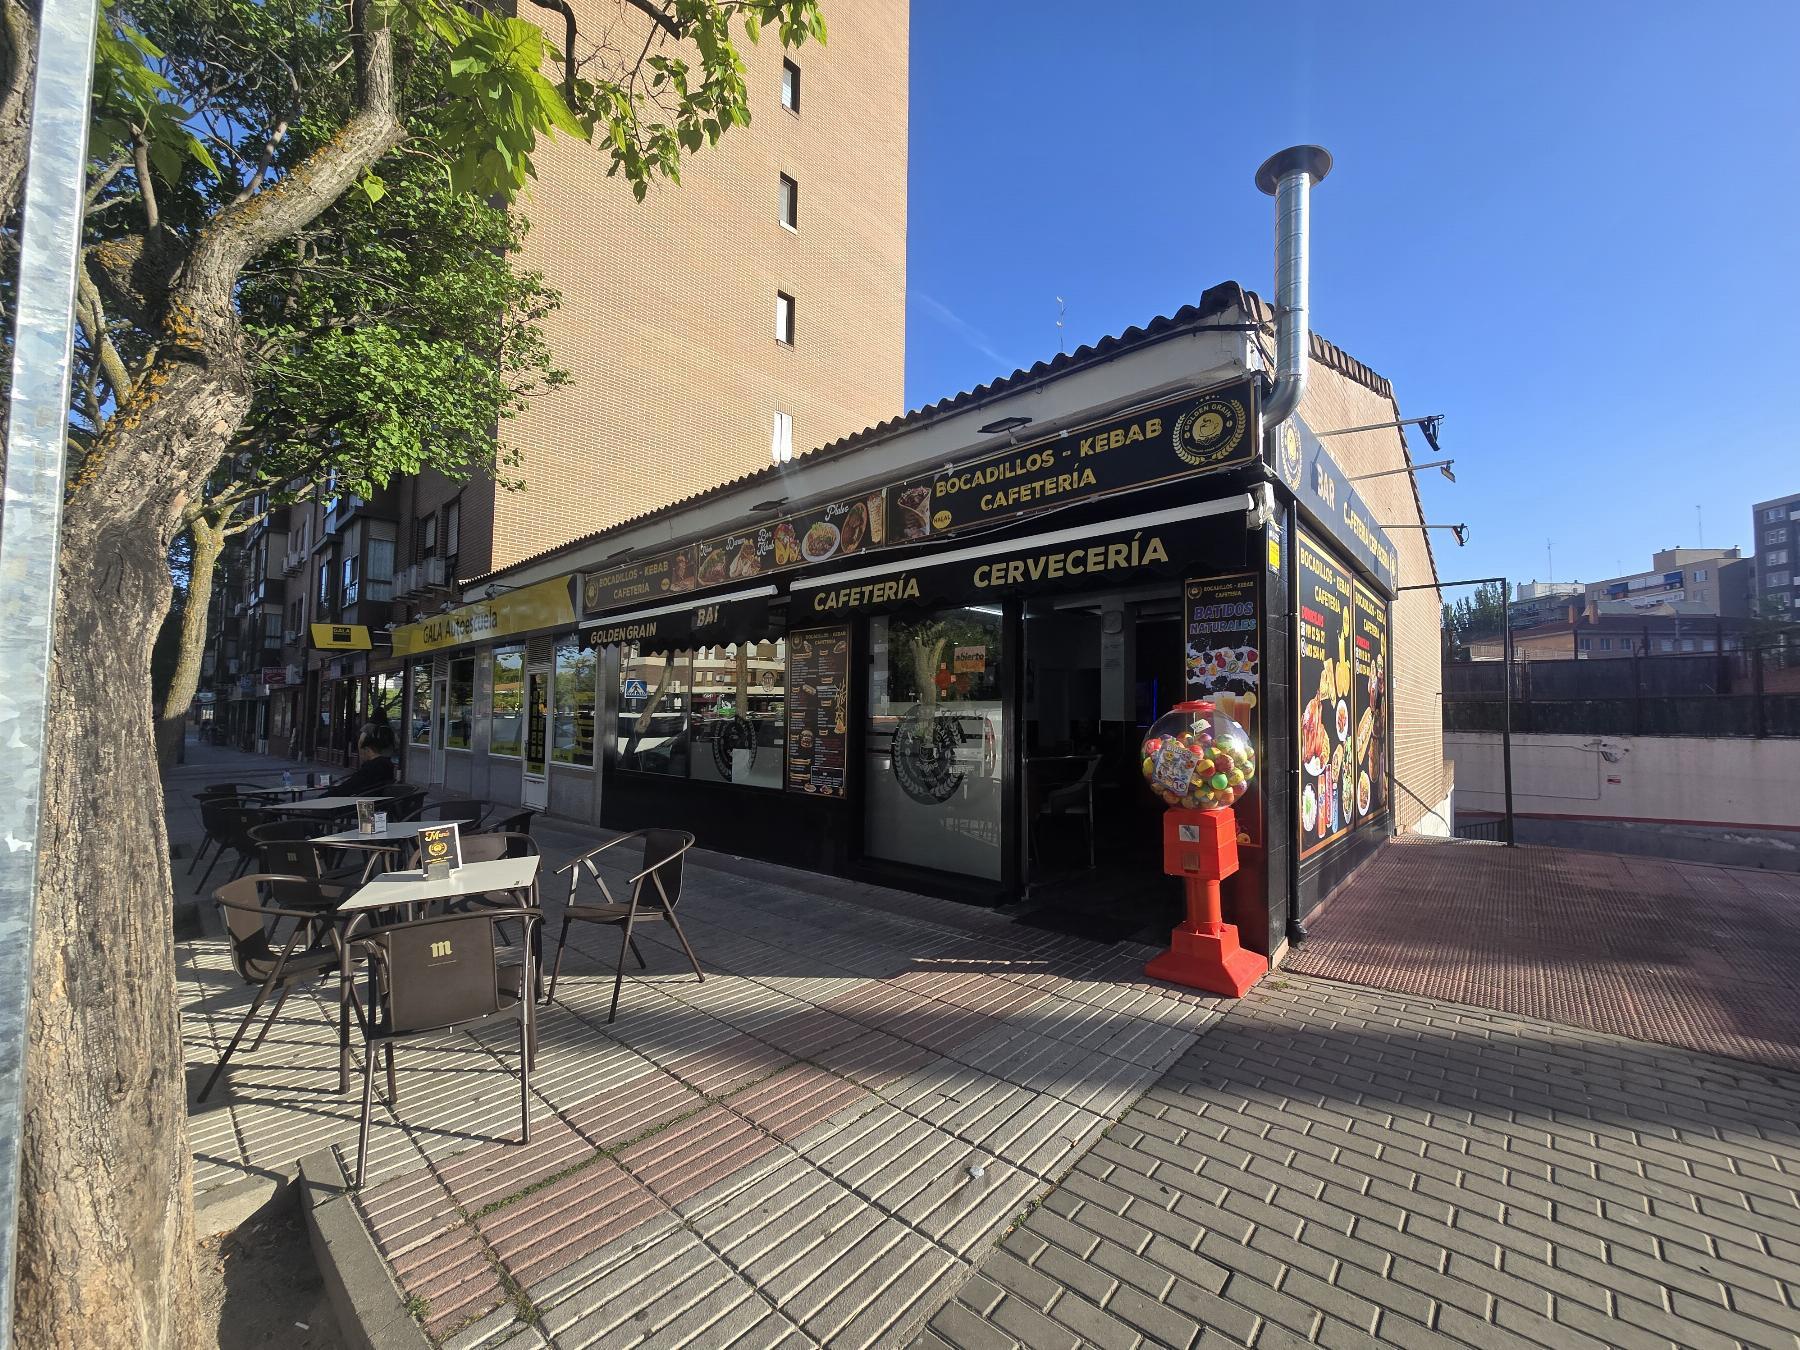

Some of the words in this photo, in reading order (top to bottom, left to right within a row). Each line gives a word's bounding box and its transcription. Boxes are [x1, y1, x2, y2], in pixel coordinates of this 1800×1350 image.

[1184, 405, 1209, 431] GOLDEN
[1211, 403, 1232, 418] GRAIN
[935, 449, 1055, 498] BOCADILLOS
[1080, 418, 1163, 458] KEBAB
[980, 467, 1097, 513] CAFETERÍA
[1317, 463, 1336, 512] BAR
[599, 569, 638, 588] BOCADILLOS
[644, 561, 670, 577] KEBAB
[973, 532, 1168, 589] CERVECERÍA
[1300, 547, 1333, 585] BOCADILLOS
[613, 582, 650, 600] CAFETERÍA
[814, 573, 920, 611] CAFETERÍA
[423, 625, 443, 645] GALA
[445, 605, 498, 638] Autoescuela
[1190, 619, 1256, 634] NATURALES
[1194, 602, 1254, 620] BATIDOS
[590, 624, 626, 644] GOLDEN
[626, 621, 657, 640] GRAIN
